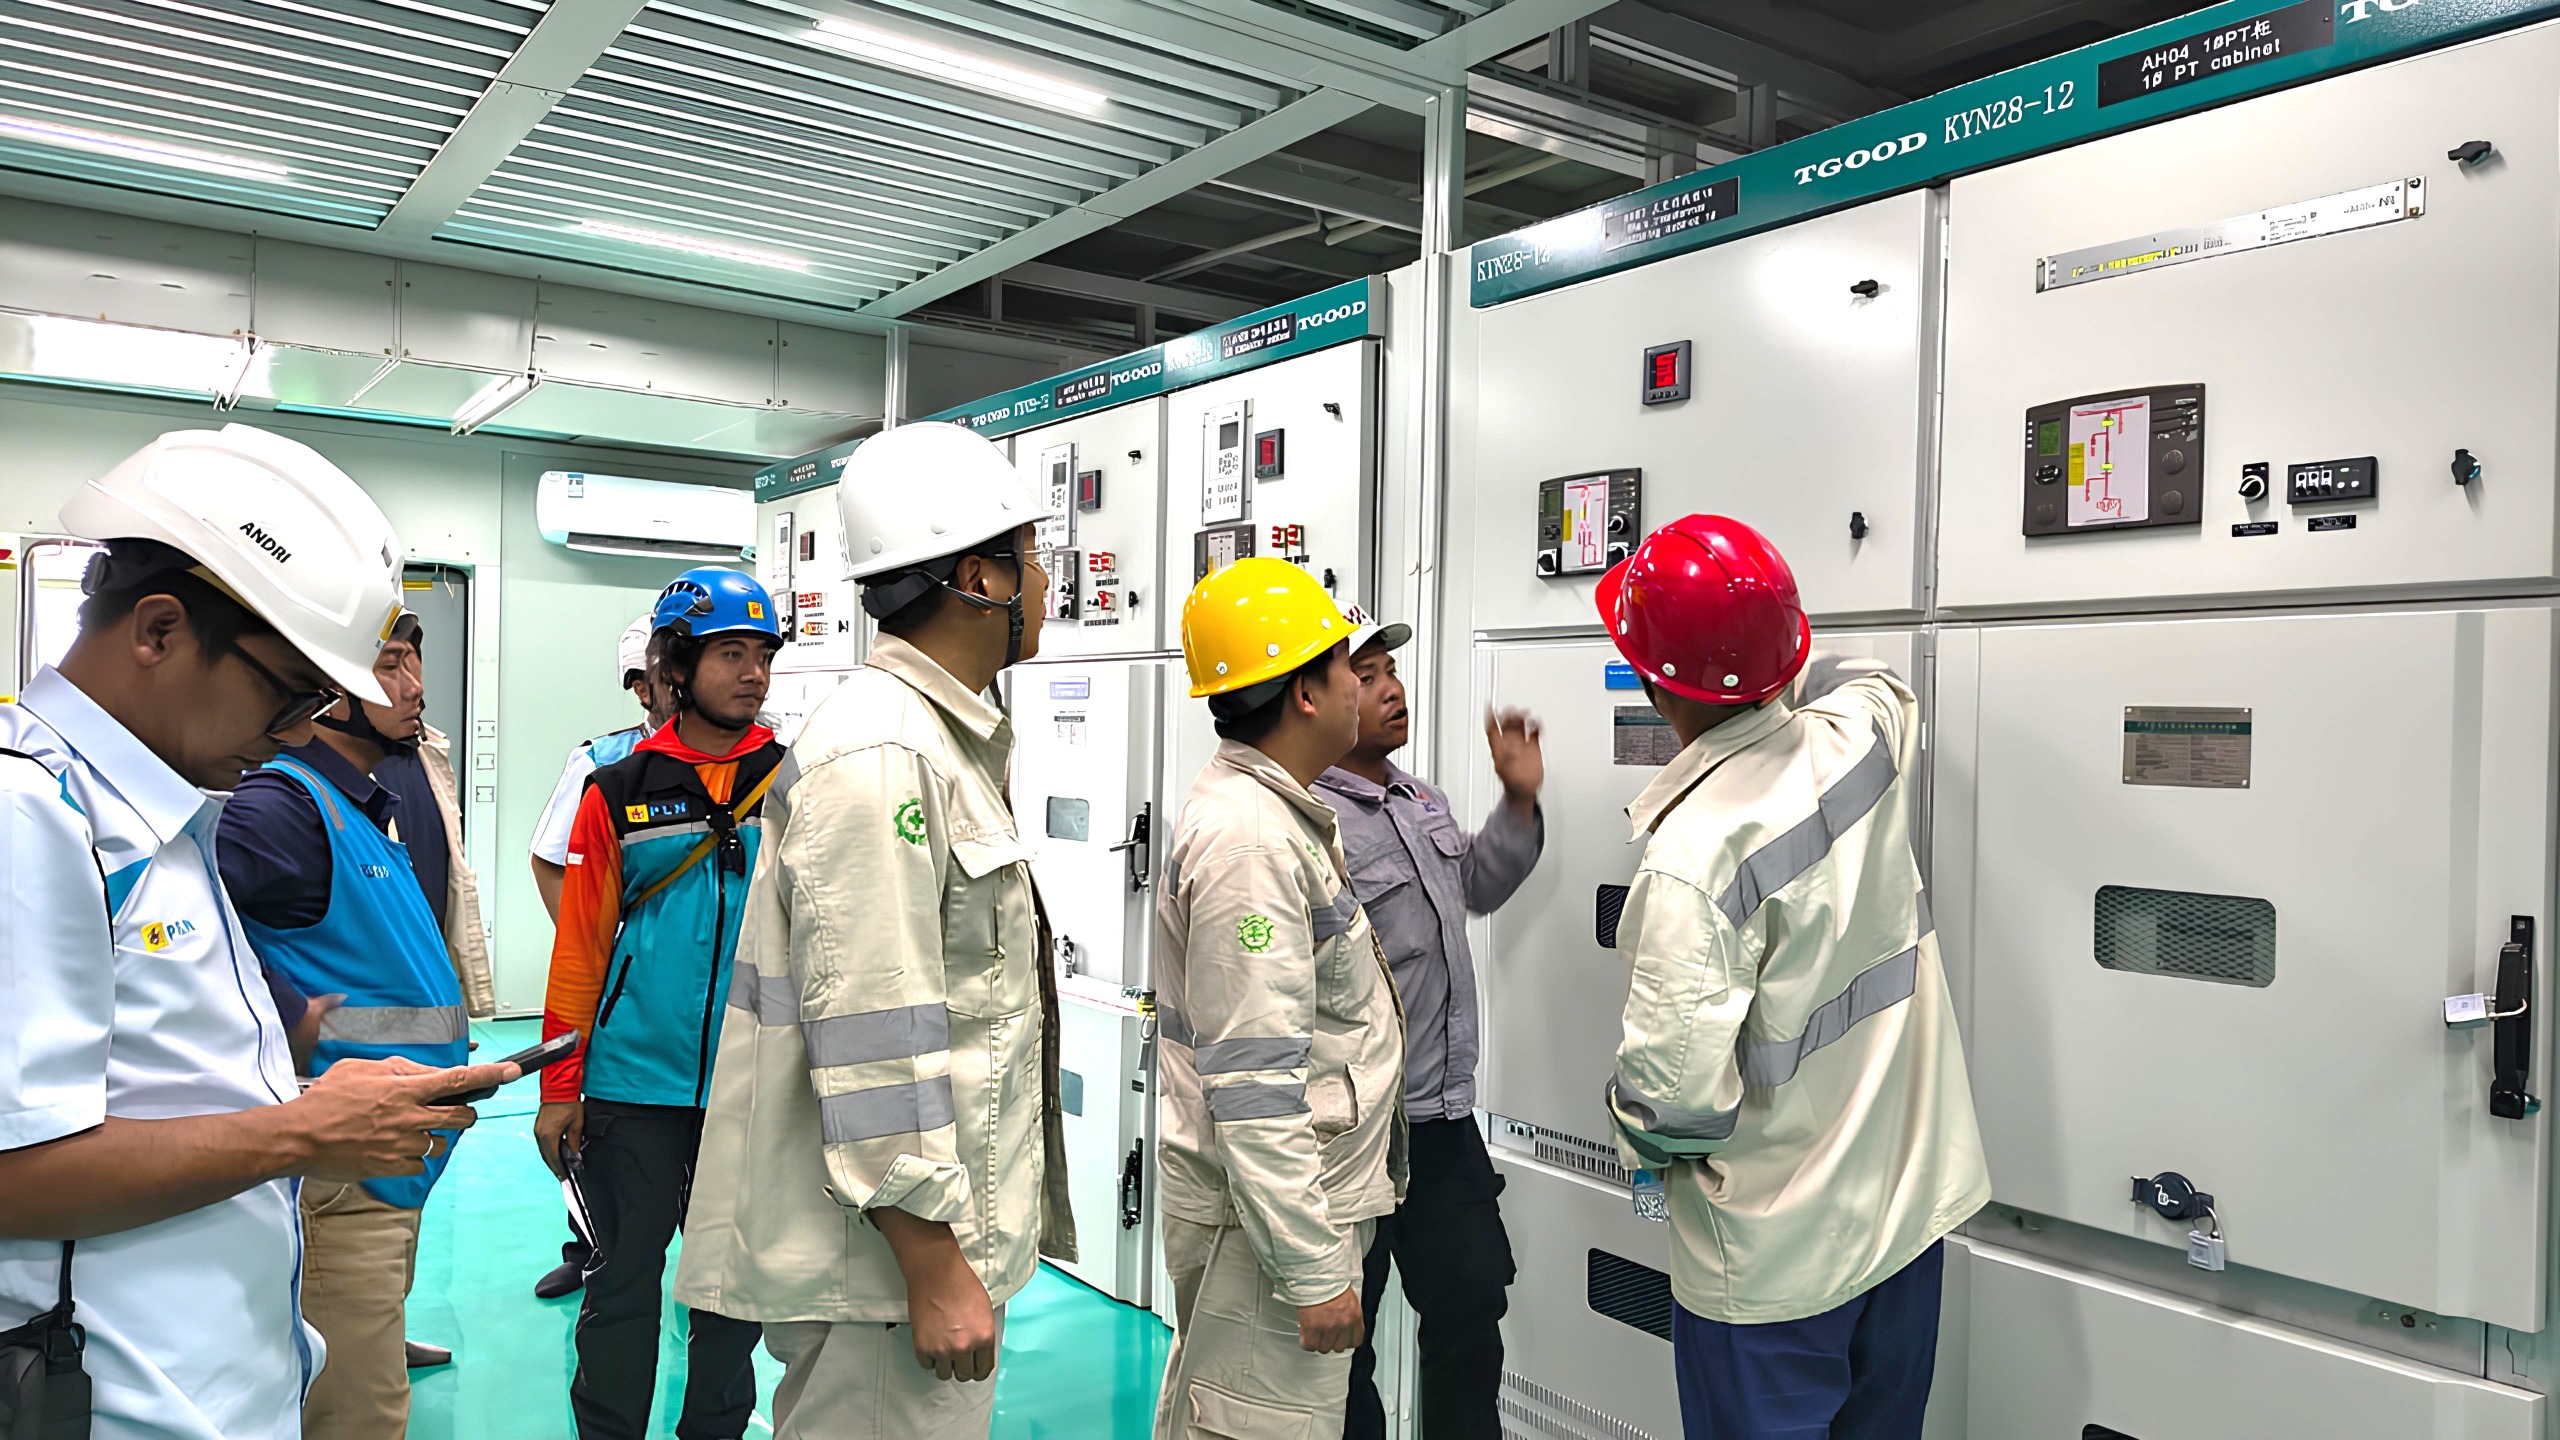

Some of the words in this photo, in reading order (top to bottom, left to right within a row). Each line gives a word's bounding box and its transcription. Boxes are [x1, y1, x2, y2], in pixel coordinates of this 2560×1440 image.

[2141, 44, 2190, 73] AH04
[2174, 61, 2199, 81] PT
[1794, 131, 1928, 185] TGOOD
[1943, 80, 2075, 144] KYN28-12
[239, 522, 292, 564] ANDRI
